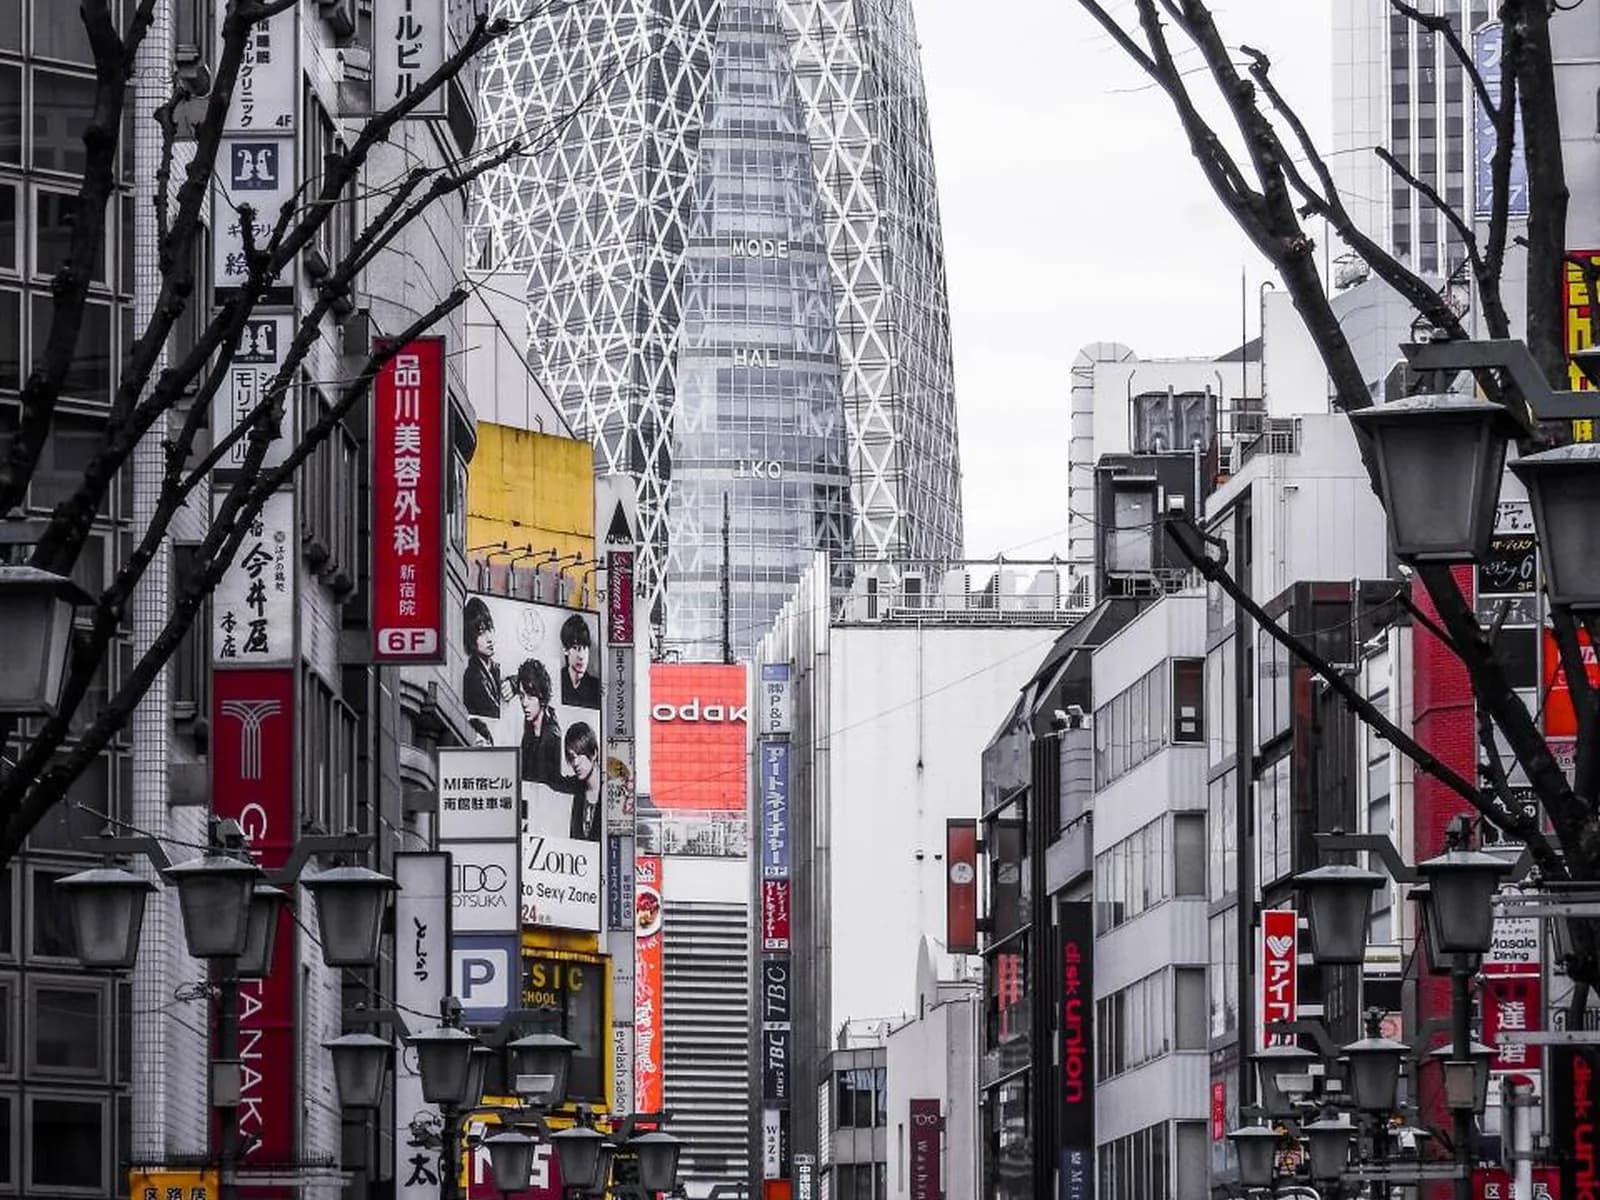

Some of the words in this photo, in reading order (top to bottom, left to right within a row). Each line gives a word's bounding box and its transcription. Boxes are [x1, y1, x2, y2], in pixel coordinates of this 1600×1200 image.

[275, 114, 292, 127] 4F
[733, 239, 788, 258] MODE
[734, 348, 779, 368] HAL
[394, 354, 421, 557] 品川美容外科
[399, 564, 416, 616] 新宿院
[387, 632, 427, 651] 6F
[528, 836, 588, 878] Zone
[536, 882, 565, 904] Sexy
[568, 886, 598, 905] Zone
[1493, 951, 1530, 962] Dining
[462, 958, 496, 999] P
[767, 966, 786, 1016] TBC
[614, 1030, 628, 1077] eyelash
[769, 1033, 785, 1070] TBC
[1065, 998, 1087, 1103] union
[616, 1079, 627, 1113] salon
